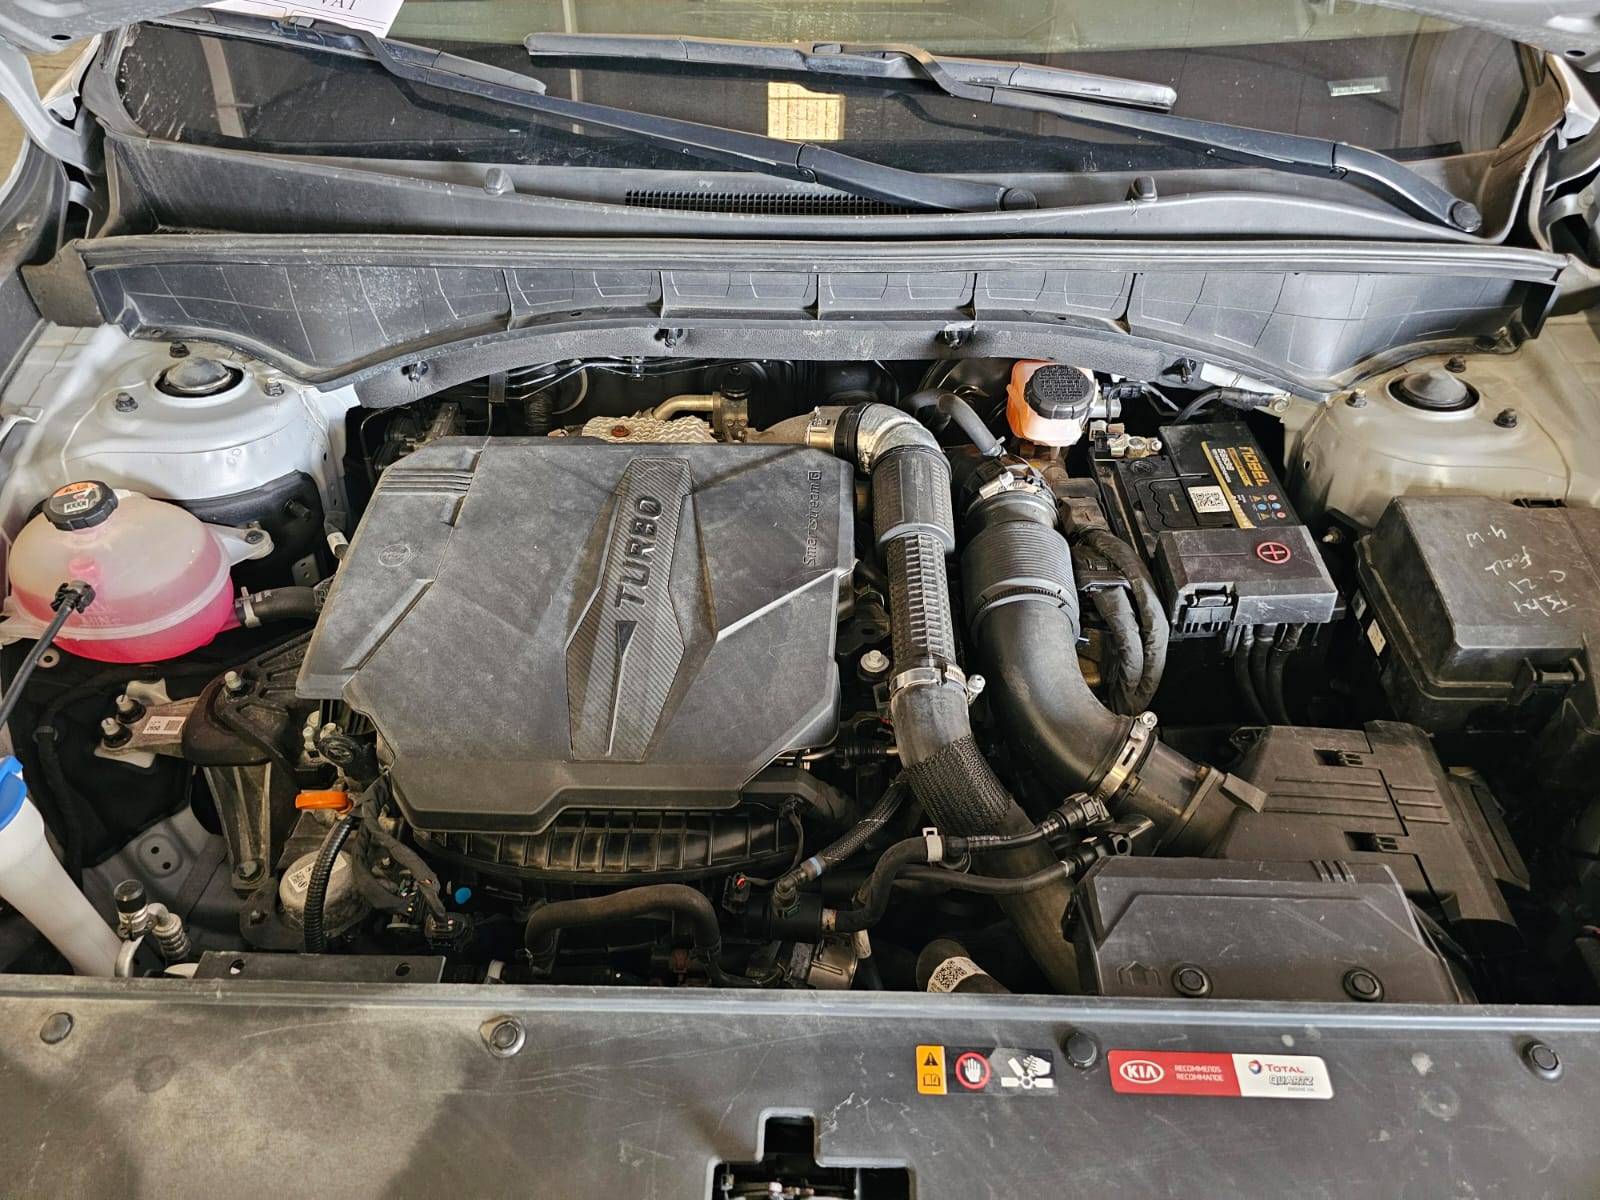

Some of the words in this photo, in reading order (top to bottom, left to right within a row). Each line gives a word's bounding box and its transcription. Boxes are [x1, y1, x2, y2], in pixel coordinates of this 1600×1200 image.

[614, 496, 664, 609] TURBO
[1126, 1064, 1158, 1079] KIA
[1174, 1064, 1222, 1073] RECOMMENDS
[1265, 1063, 1304, 1074] TOTAL
[1176, 1073, 1224, 1082] RECOMMANDE
[1269, 1075, 1315, 1086] QUARTZ
